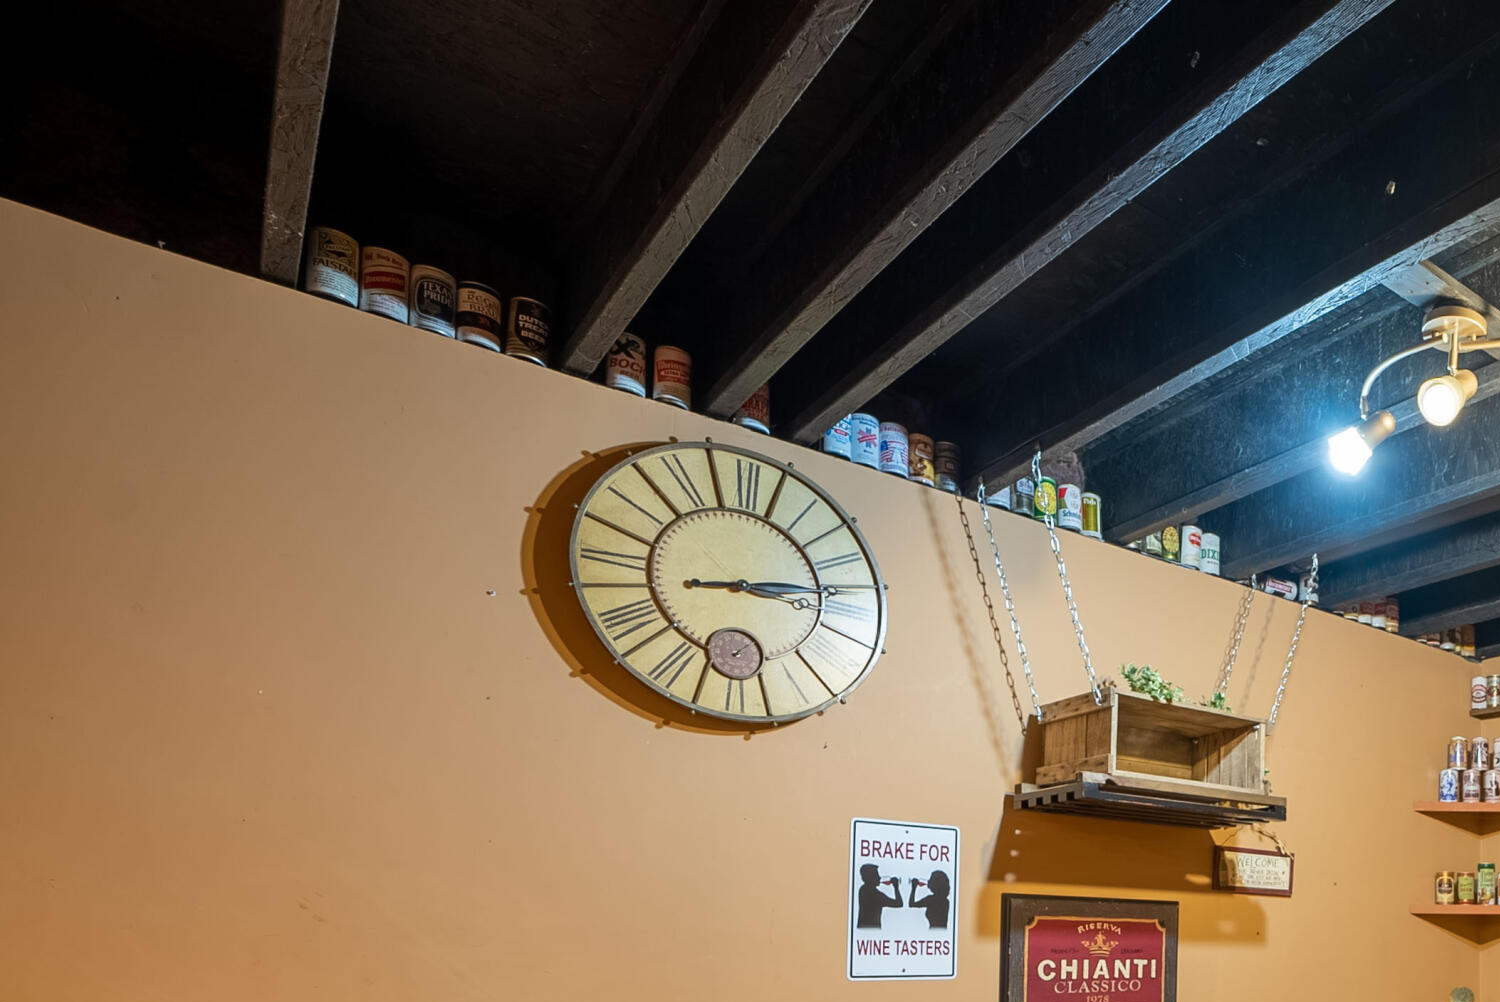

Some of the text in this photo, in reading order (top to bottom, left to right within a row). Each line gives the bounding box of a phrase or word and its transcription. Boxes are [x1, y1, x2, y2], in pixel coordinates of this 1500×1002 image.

[860, 839, 950, 862] BRAKE FOR
[1077, 922, 1122, 935] RISERVA
[857, 940, 950, 956] WINE TASTERS
[1037, 958, 1157, 981] CHIANTI
[1054, 979, 1142, 994] CLASSICO
